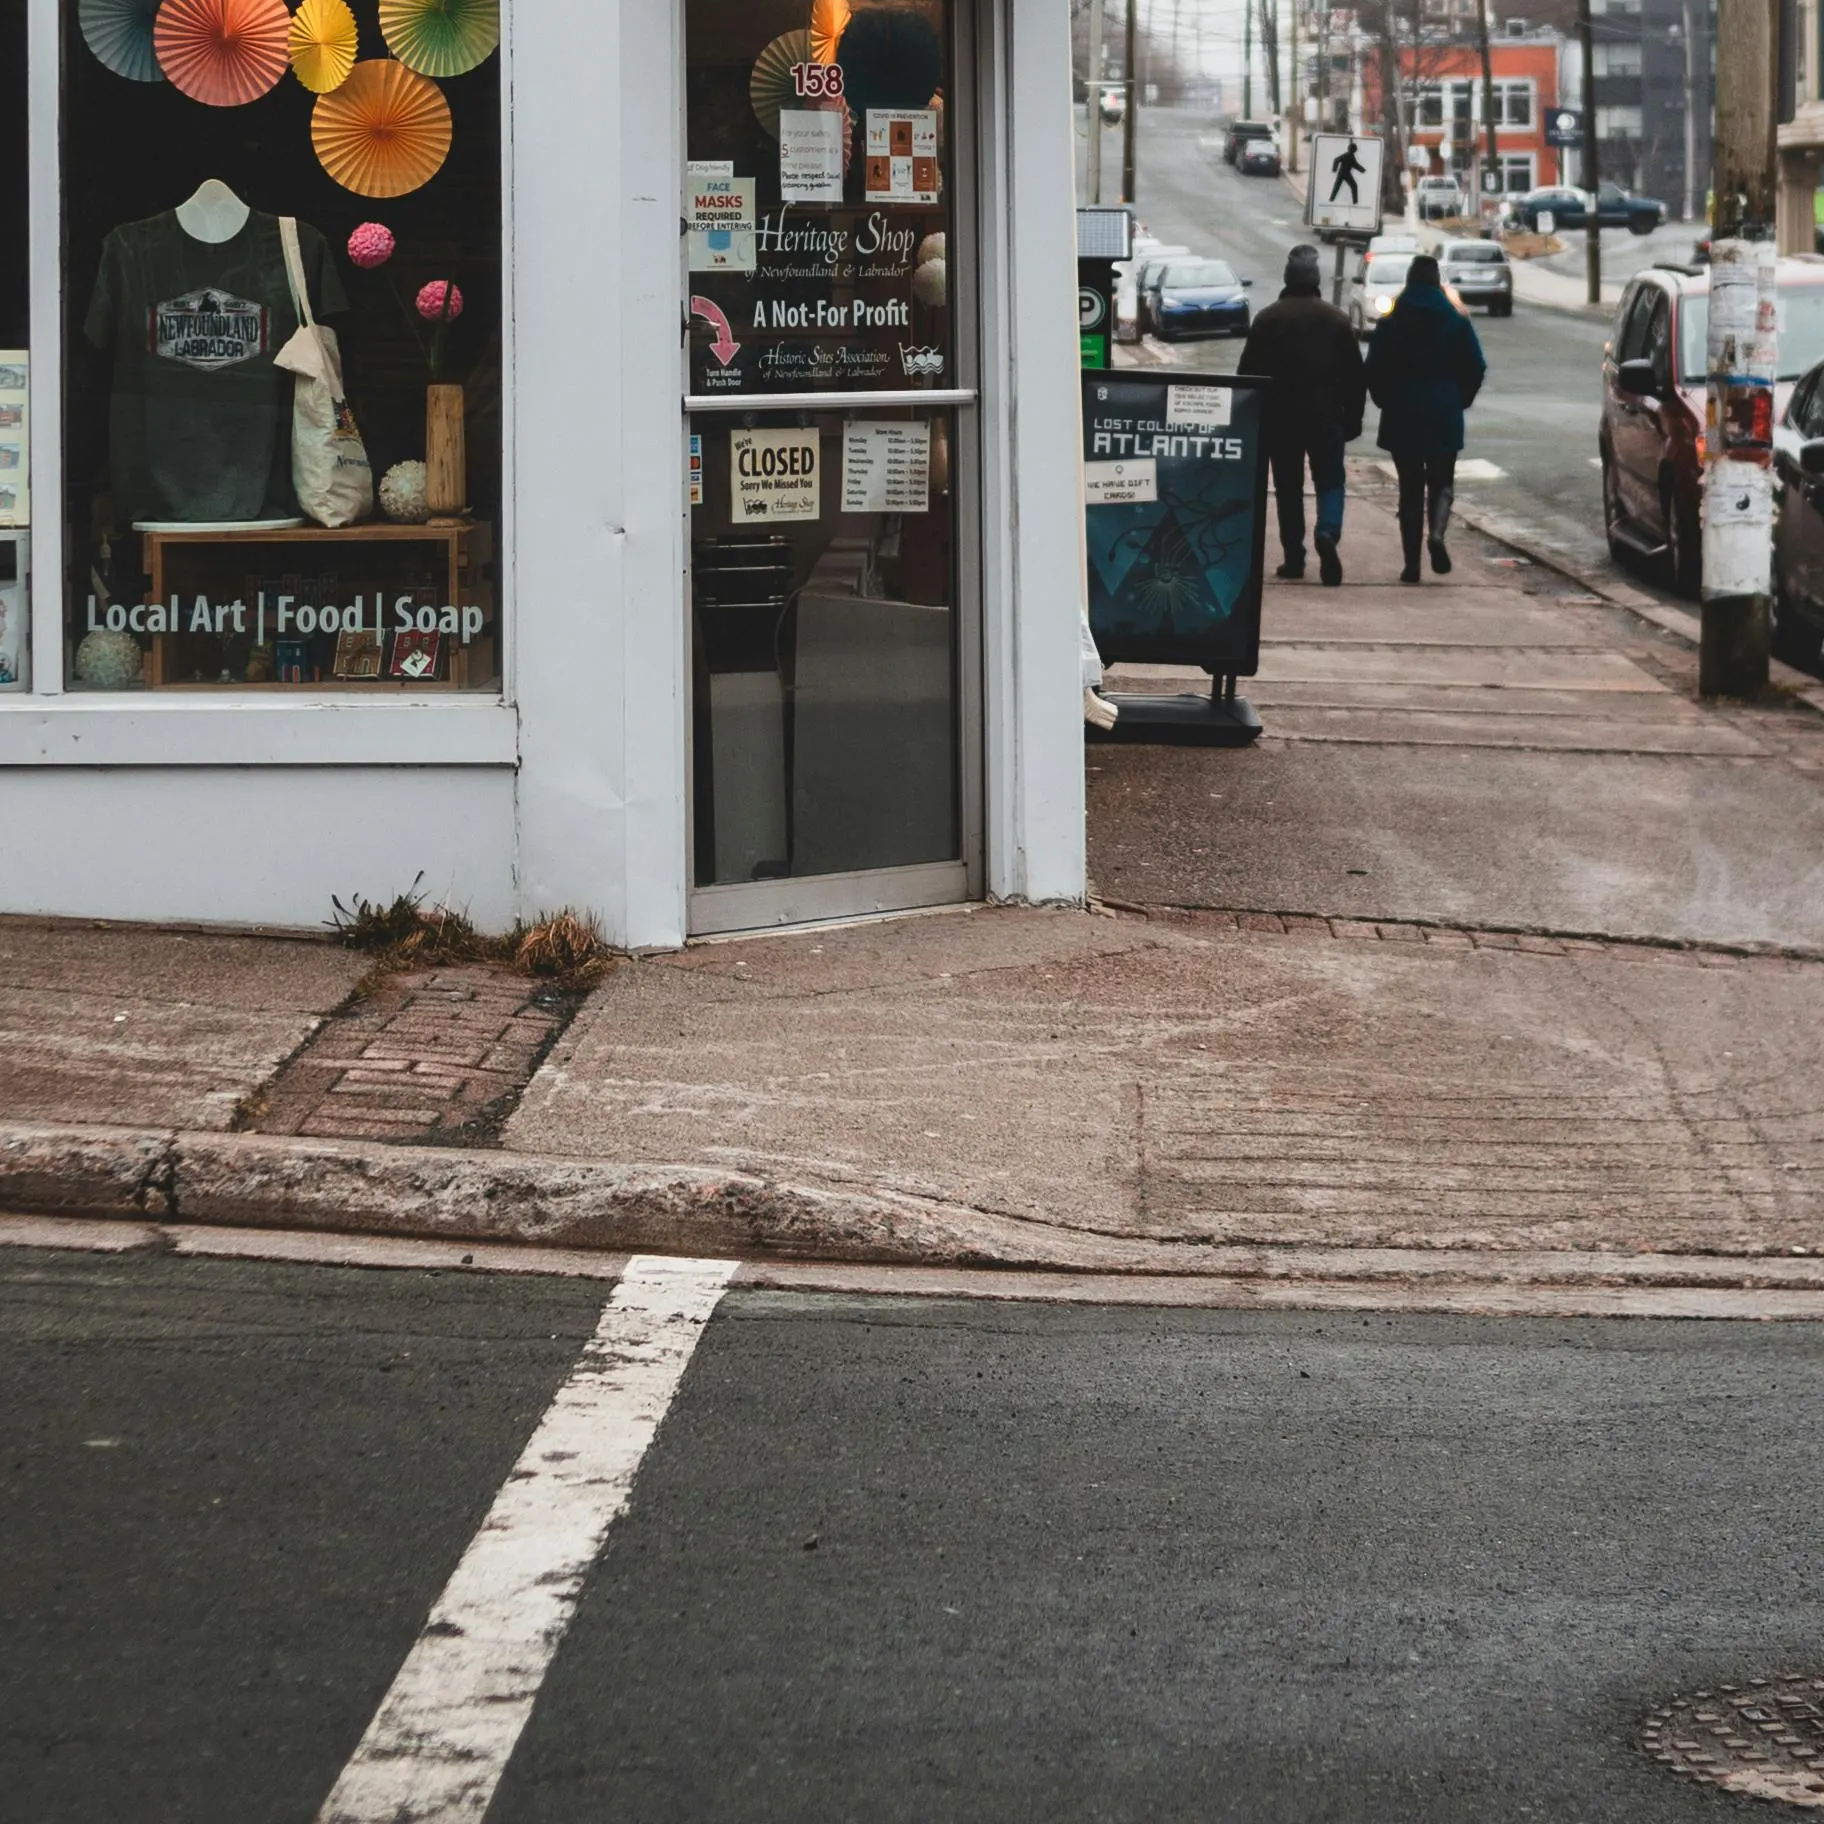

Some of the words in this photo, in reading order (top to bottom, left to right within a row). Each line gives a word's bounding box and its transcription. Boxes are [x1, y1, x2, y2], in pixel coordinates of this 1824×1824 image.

[790, 62, 844, 97] 158
[781, 143, 789, 157] 5
[707, 183, 731, 192] FACE
[695, 196, 743, 208] MASKS
[696, 212, 742, 221] REQUIRED
[716, 222, 752, 231] ENTERING
[740, 201, 847, 263] Heritage
[855, 212, 915, 263] Shop
[760, 263, 838, 282] Newfoundland
[843, 265, 856, 277] &
[859, 264, 911, 277] Labrador
[753, 300, 766, 327] A
[773, 299, 848, 327] Not-For
[853, 297, 909, 326] Profit
[159, 315, 258, 343] NEWFOUNDLAND
[175, 338, 244, 357] LABRADOR
[759, 341, 805, 368] Historic
[808, 345, 834, 365] Sites
[835, 346, 890, 364] Association
[1094, 417, 1133, 430] LOST
[1137, 420, 1195, 433] COLONY
[1198, 423, 1216, 434] OF
[1093, 431, 1242, 460] ATLANTIS
[738, 446, 815, 477] CLOSED
[740, 480, 761, 493] Sorry
[761, 480, 773, 490] We
[774, 479, 798, 489] Missed
[800, 478, 813, 489] You
[87, 594, 179, 633] Local
[189, 594, 247, 633] Art
[277, 594, 364, 633] Food
[394, 595, 484, 644] Soap
